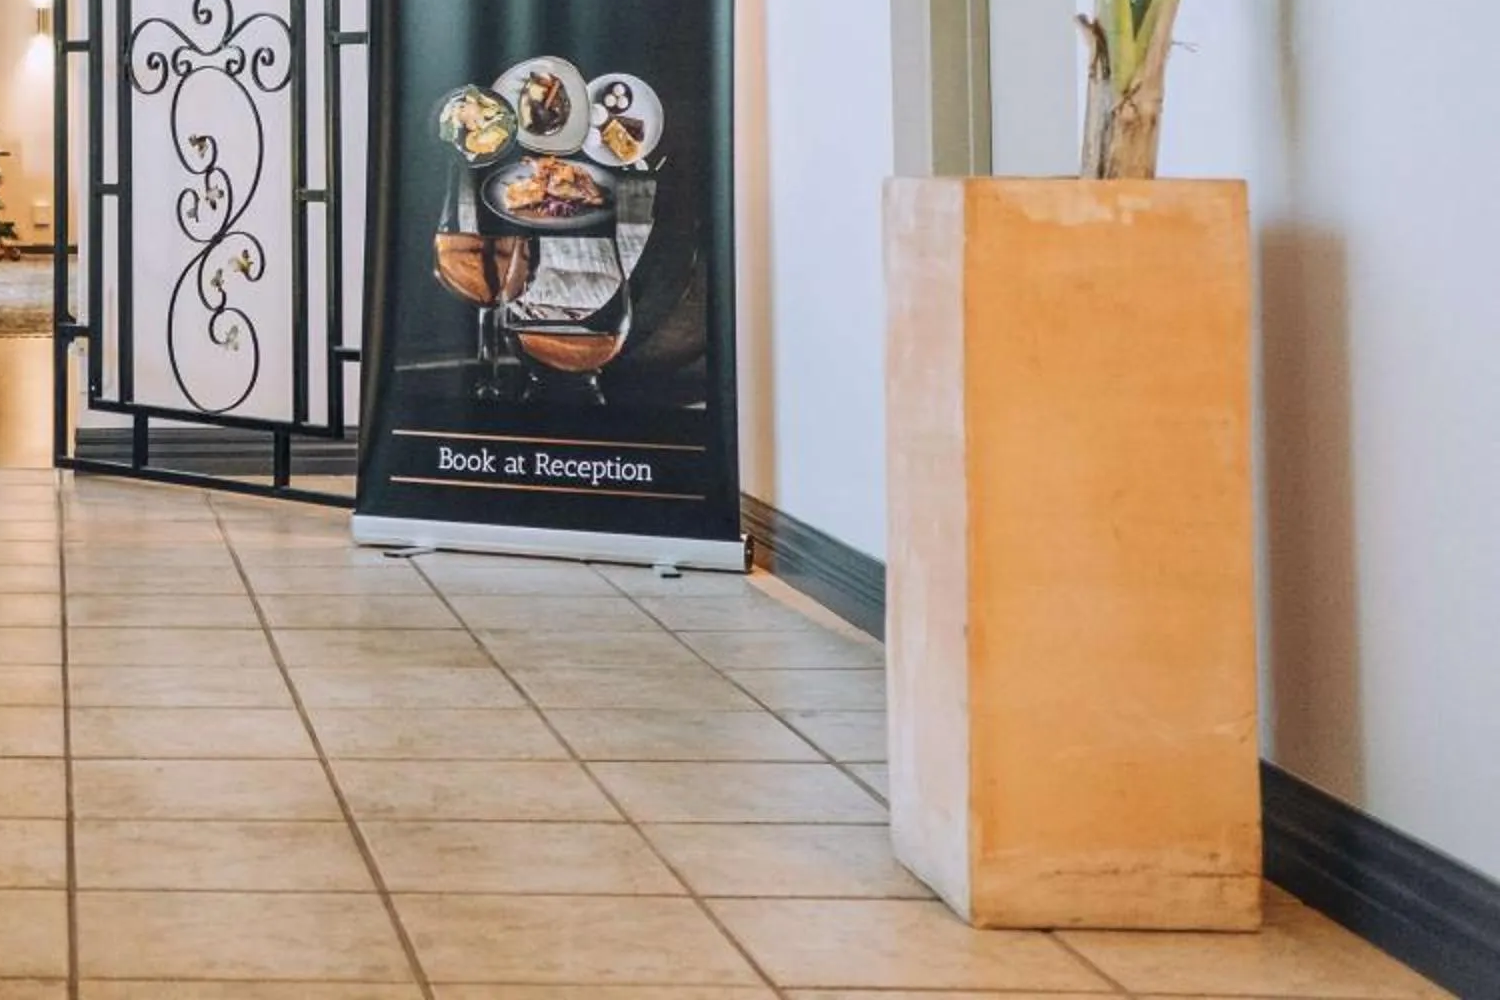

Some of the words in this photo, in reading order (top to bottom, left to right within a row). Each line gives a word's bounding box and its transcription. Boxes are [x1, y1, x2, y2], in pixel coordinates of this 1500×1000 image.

[438, 447, 496, 473] Book
[504, 456, 526, 475] at
[534, 453, 652, 486] Reception
